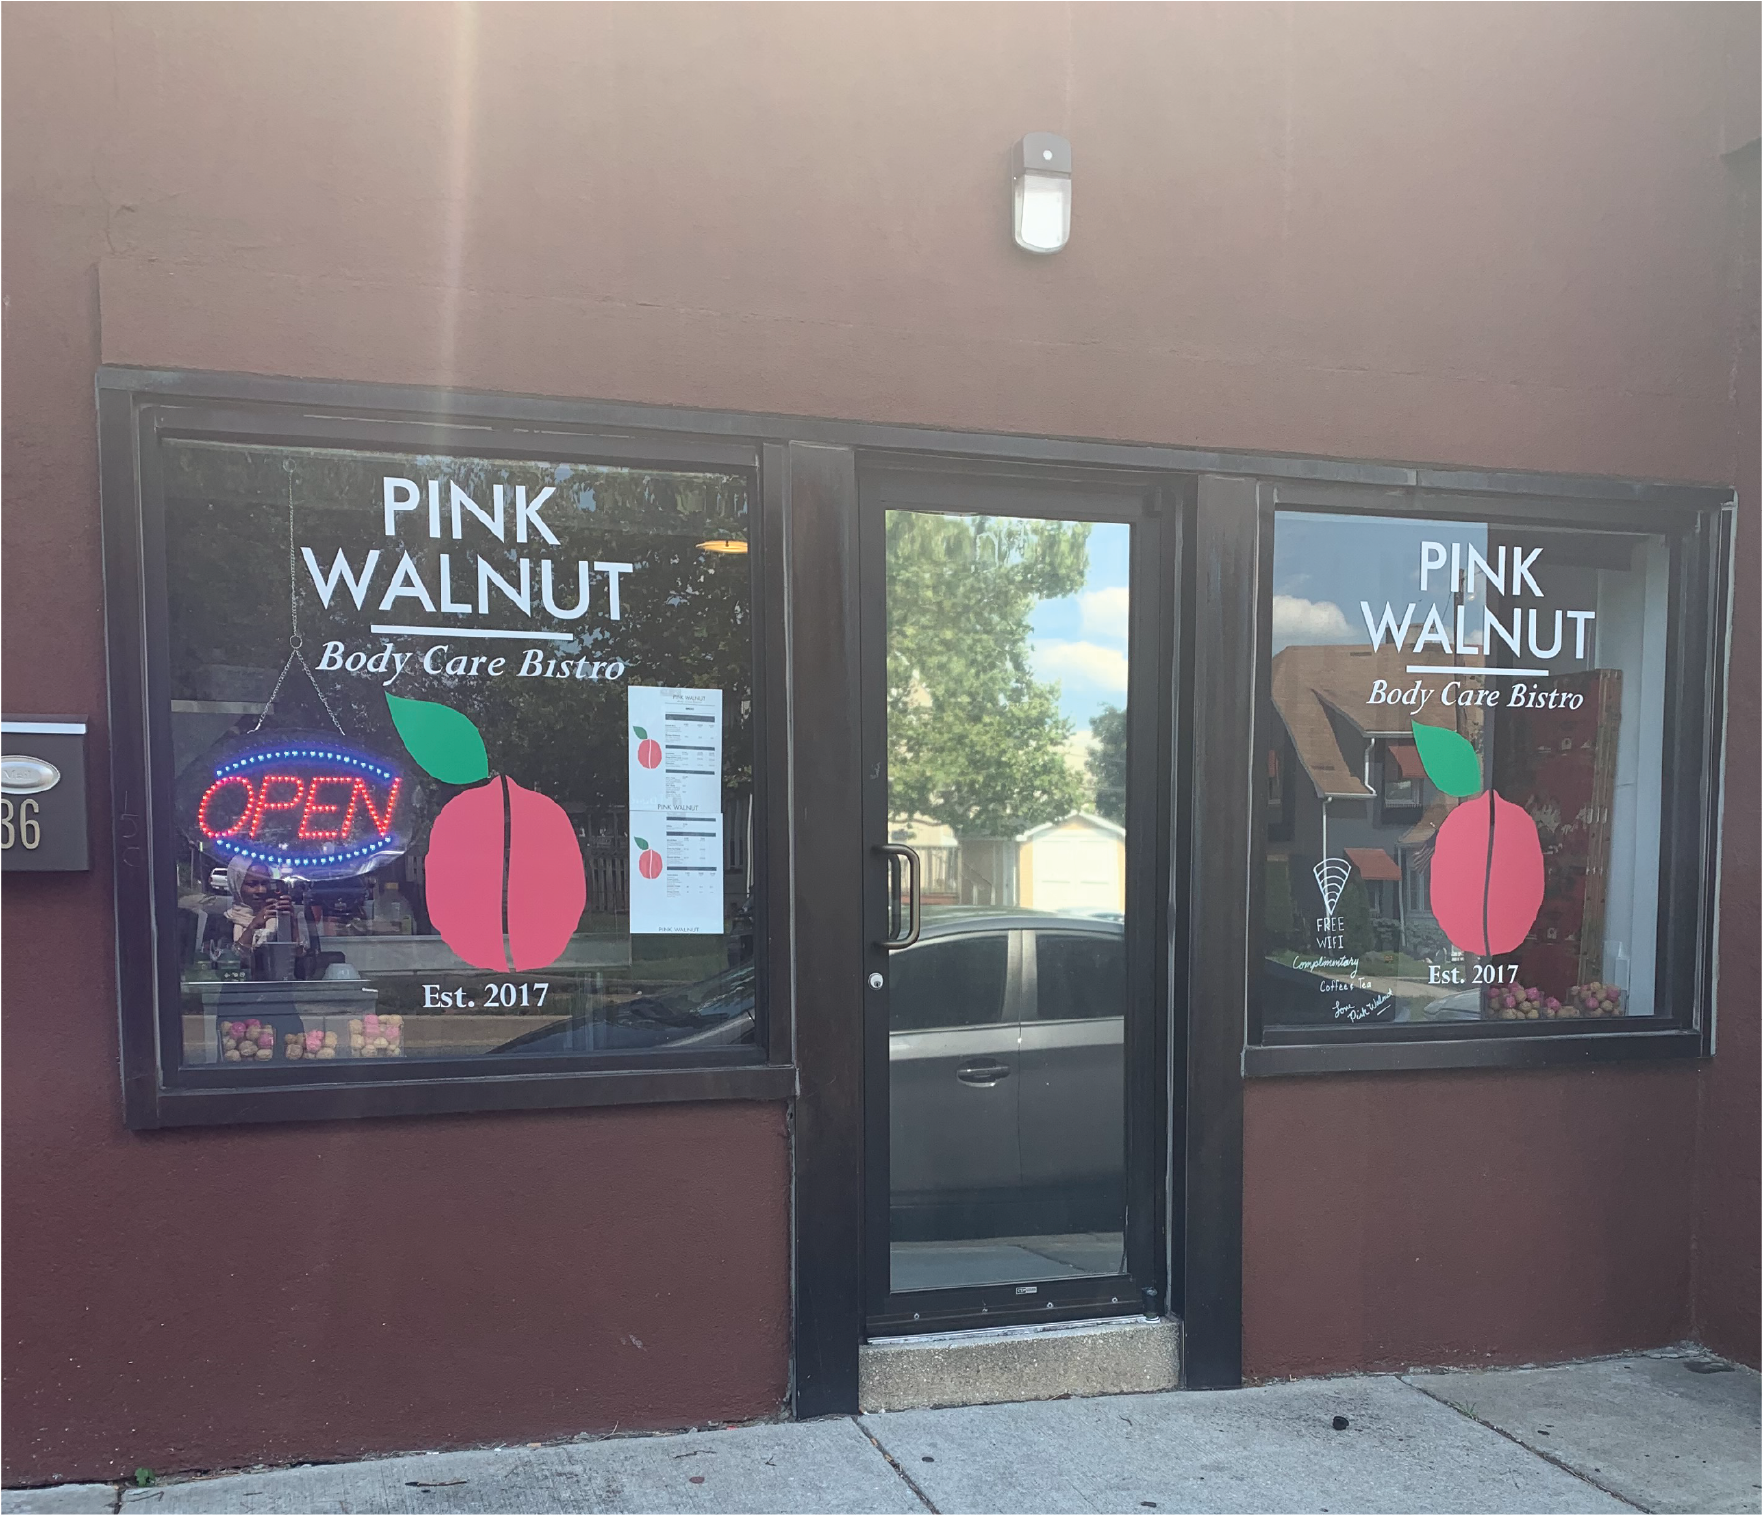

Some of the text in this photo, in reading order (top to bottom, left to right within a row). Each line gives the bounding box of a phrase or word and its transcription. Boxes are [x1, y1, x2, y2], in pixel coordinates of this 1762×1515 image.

[383, 476, 561, 546] PINK
[300, 546, 634, 621] WALNUT
[1420, 540, 1545, 598] PINK
[1360, 600, 1596, 660] WALNUT
[314, 640, 625, 687] Body Care Bistro
[1365, 679, 1584, 716] Body Care Bistro
[197, 775, 402, 840] OPEN
[657, 803, 699, 812] PINK WALNUT
[1316, 917, 1345, 932] FREE
[1316, 935, 1344, 949] WIFI
[1320, 979, 1348, 992] Coffee
[1358, 977, 1372, 989] Tea
[1427, 963, 1519, 985] Est. 2017
[422, 982, 549, 1008] Est. 2017
